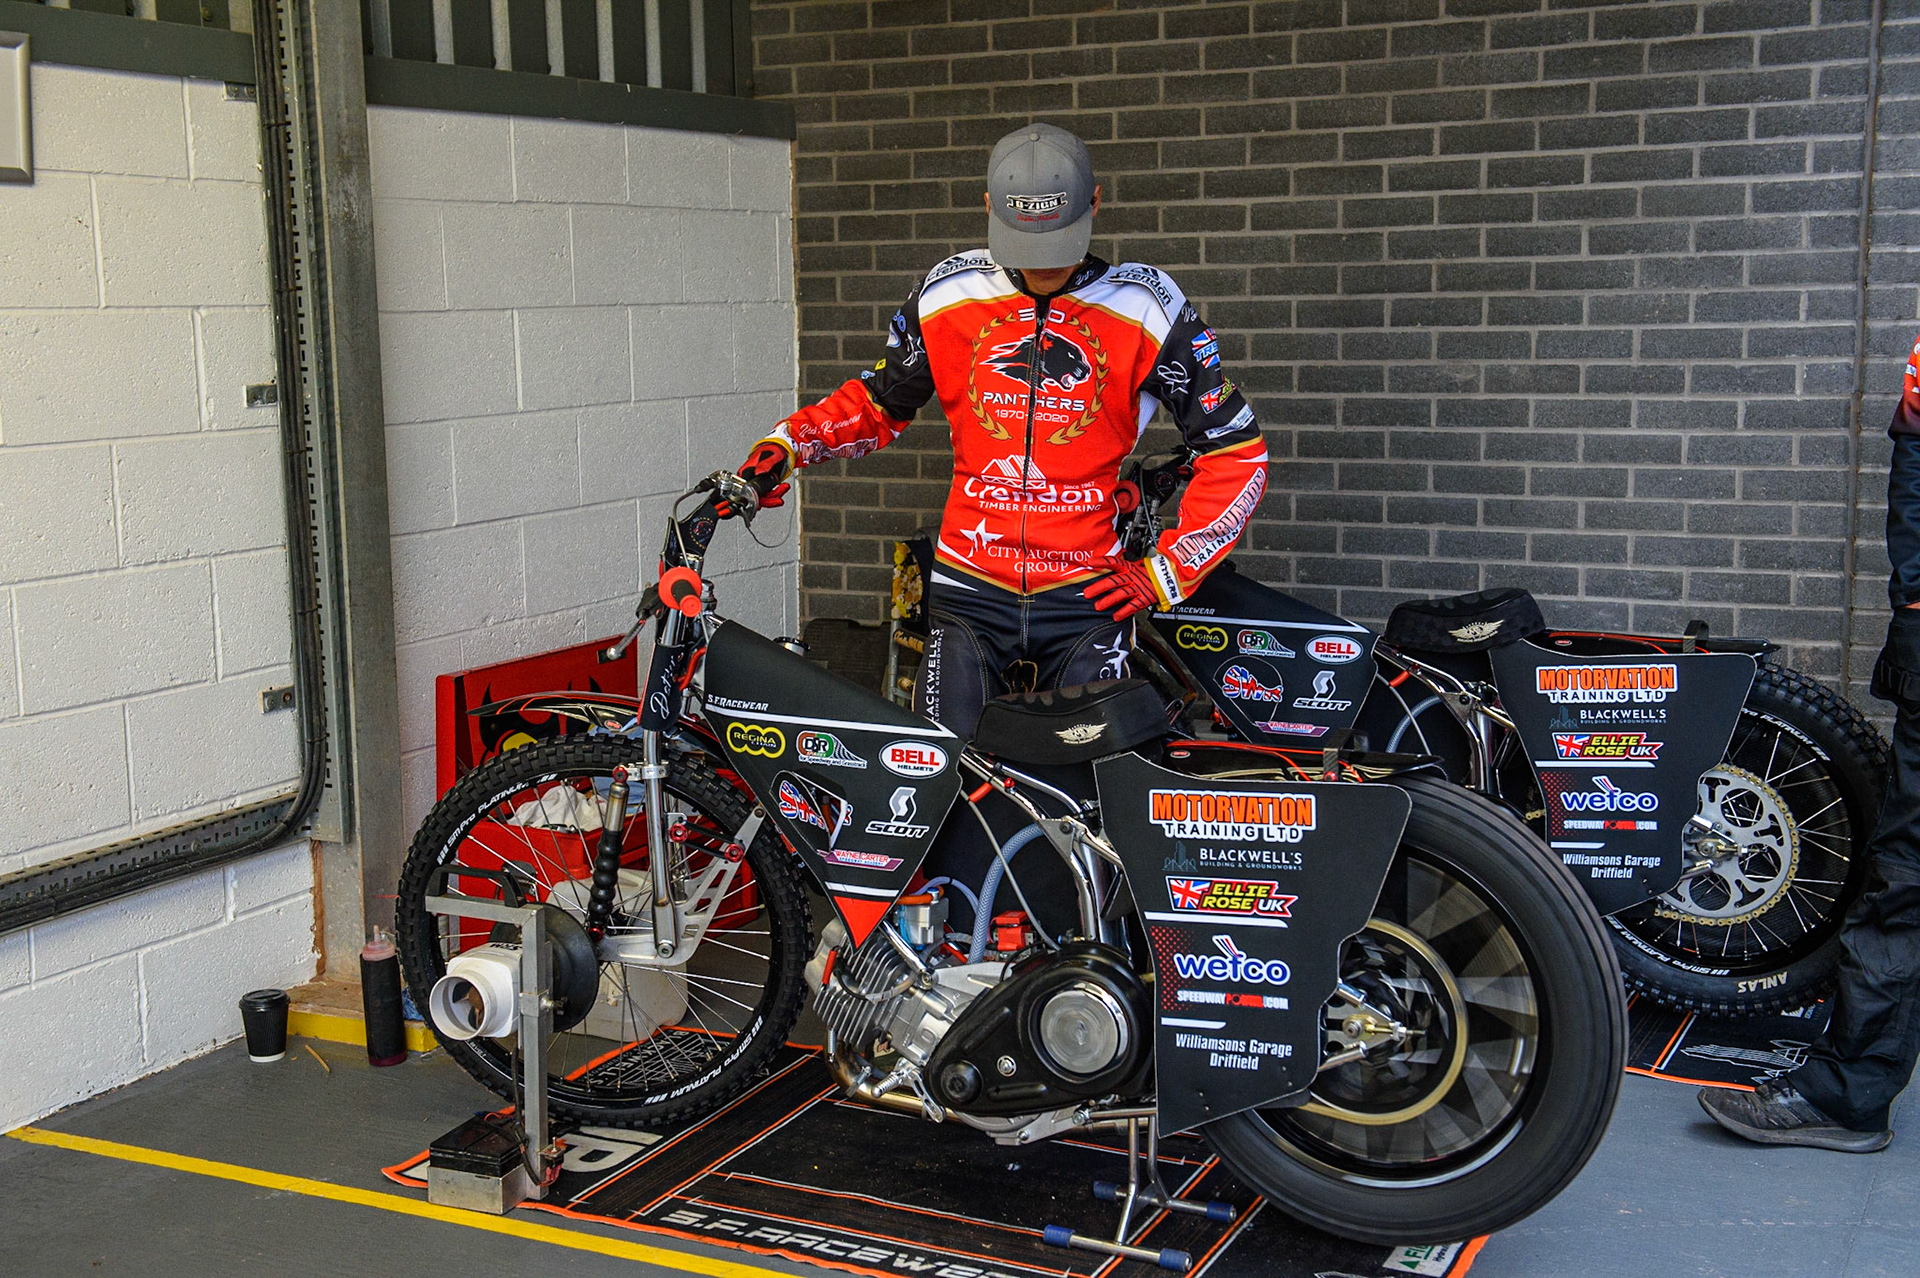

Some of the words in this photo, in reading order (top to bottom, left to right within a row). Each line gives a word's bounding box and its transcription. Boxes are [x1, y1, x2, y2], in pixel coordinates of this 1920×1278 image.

[1110, 270, 1171, 305] Crendon
[983, 391, 1085, 411] PANTHERS
[964, 477, 1104, 504] Crendon
[979, 501, 1019, 511] TIMBER
[1023, 504, 1101, 513] ENGINEERING
[1171, 470, 1265, 564] MOTORVATION
[988, 546, 1021, 559] CITY
[1025, 550, 1093, 562] AUCTION
[1014, 561, 1068, 573] GROUP
[1184, 631, 1220, 642] REGINA
[1315, 641, 1355, 655] BELL
[1540, 667, 1675, 691] MOTORVATION
[1550, 690, 1626, 701] TRAINING
[1636, 690, 1664, 701] LTD
[1295, 699, 1349, 710] SCOTT
[1580, 709, 1666, 719] BLACKWELL'S
[734, 732, 776, 744] REGINA
[1591, 736, 1640, 746] ELLIE
[891, 748, 940, 766] BELL
[1583, 746, 1627, 756] ROSE
[1630, 746, 1653, 756] UK
[897, 764, 934, 772] HELMETS
[1562, 791, 1657, 811] wefco
[1153, 793, 1312, 826] MOTORVATION
[868, 823, 927, 837] SCOTT
[1167, 823, 1255, 838] TRAINING
[1266, 826, 1300, 840] LTD
[835, 850, 860, 859] WAYNE
[860, 853, 890, 862] CARTER
[1200, 848, 1302, 864] BLACKWELL'S
[1563, 854, 1622, 866] Williamsons
[1625, 855, 1661, 868] Garage
[1591, 867, 1633, 878] Driffield
[1212, 883, 1270, 897] ELLIE
[1202, 896, 1254, 910] ROSE
[1258, 898, 1286, 912] UK
[1176, 953, 1288, 982] wefco
[1737, 971, 1788, 993] ANLAS
[1176, 1033, 1246, 1053] Williamsons
[1249, 1038, 1293, 1057] Garage
[1210, 1052, 1259, 1070] Driffield
[671, 1065, 721, 1099] PLATINUM
